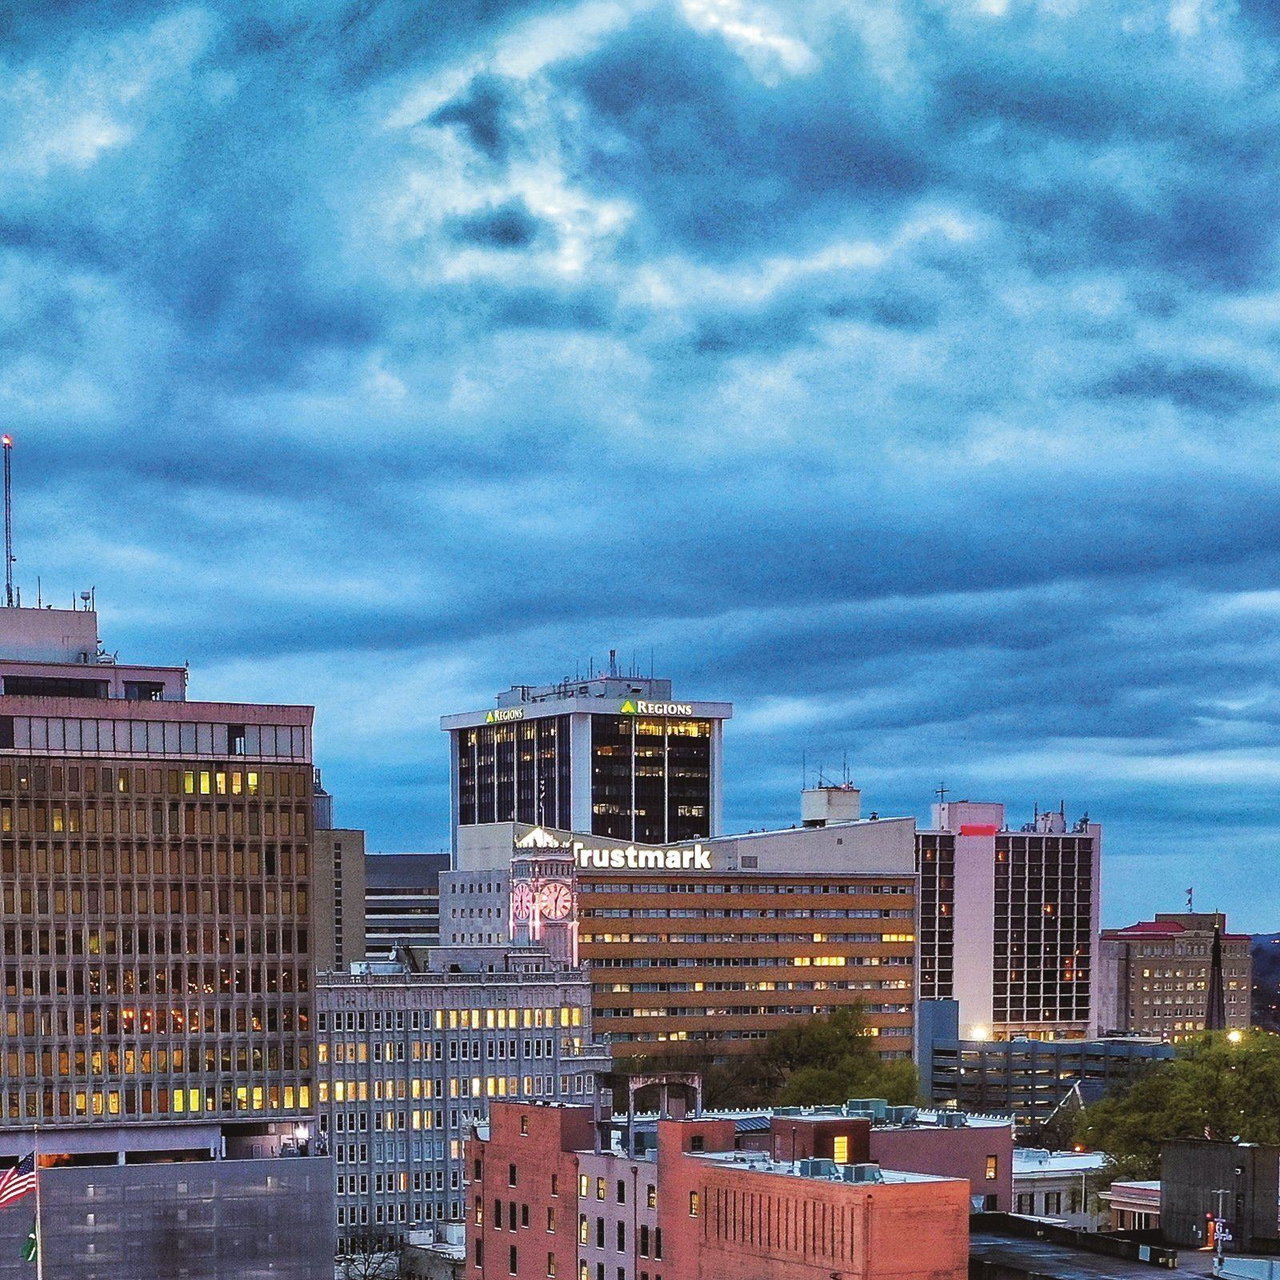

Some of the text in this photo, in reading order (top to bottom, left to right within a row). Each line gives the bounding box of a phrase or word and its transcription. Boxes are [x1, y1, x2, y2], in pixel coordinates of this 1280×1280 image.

[637, 700, 692, 715] REGIONS
[494, 709, 523, 722] REGIONS
[574, 843, 712, 869] Trustmark
